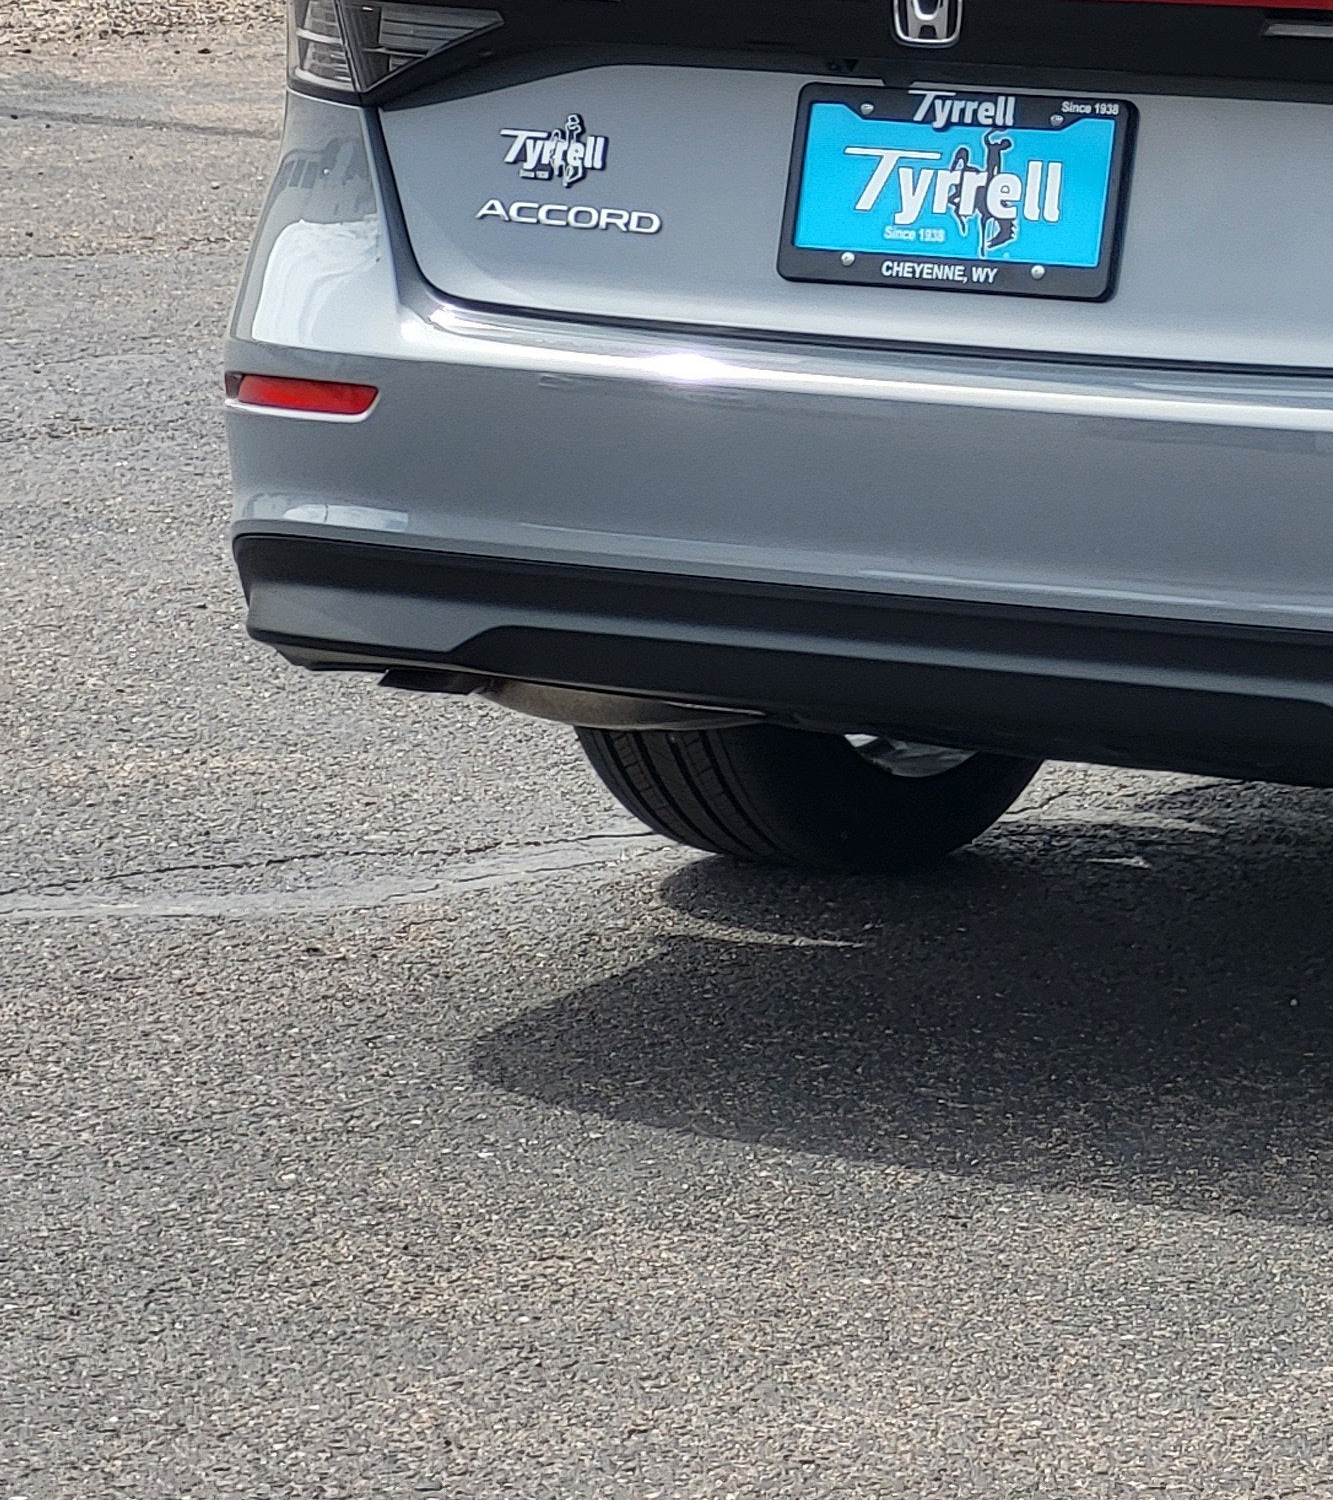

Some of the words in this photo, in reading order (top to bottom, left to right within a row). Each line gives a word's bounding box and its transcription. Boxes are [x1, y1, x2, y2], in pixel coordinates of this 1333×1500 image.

[907, 88, 1016, 128] Tyrrell
[1061, 100, 1092, 114] Since
[1094, 102, 1120, 116] 1938
[500, 127, 608, 171] Tyrrell
[843, 145, 1063, 225] Tyrrell
[474, 198, 663, 235] ACCORD
[884, 225, 916, 241] Since
[881, 260, 968, 284] CHEYENNE,
[971, 265, 998, 284] WY
